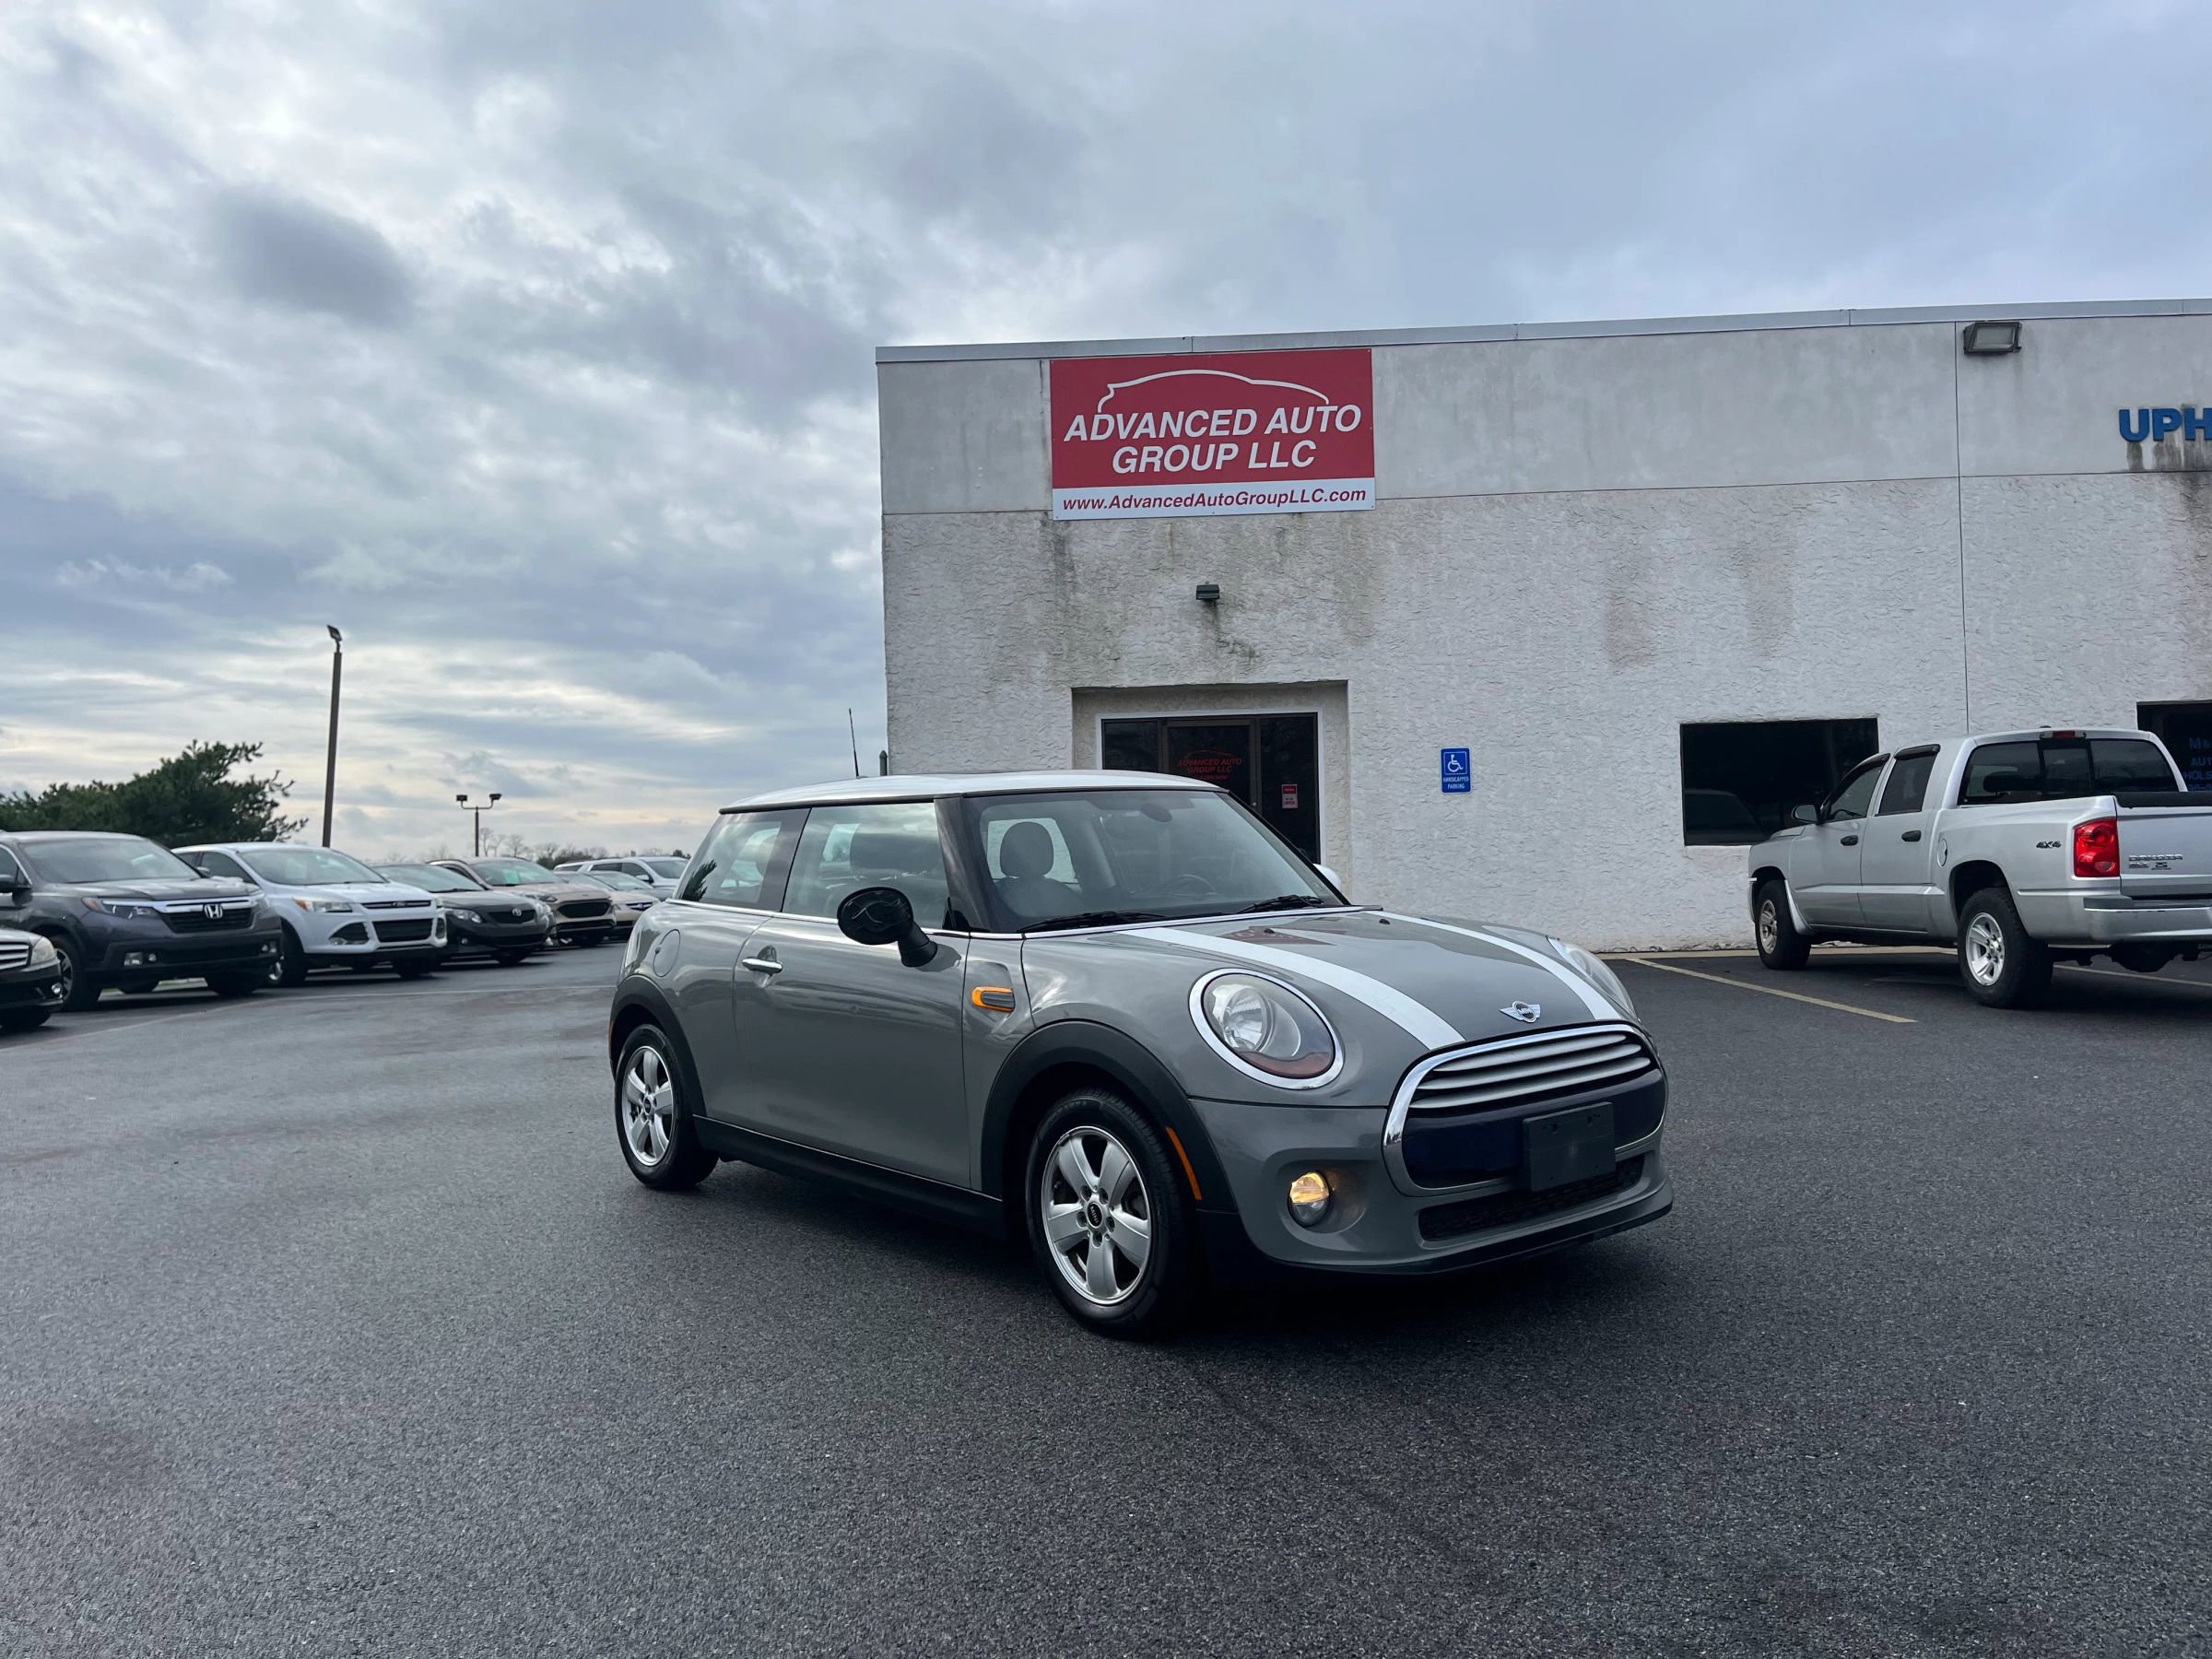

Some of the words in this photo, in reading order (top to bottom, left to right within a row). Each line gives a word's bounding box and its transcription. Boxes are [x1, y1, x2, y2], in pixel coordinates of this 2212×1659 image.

[1064, 409, 1257, 441] ADVANCED
[1265, 404, 1361, 435] AUTO
[2119, 408, 2212, 442] UPH
[1112, 443, 1239, 474] GROUP
[1247, 440, 1316, 469] LLC
[1063, 488, 1367, 511] www.AdvancedAutoGroupLLC.com
[1179, 759, 1219, 767] ADVANCED
[1220, 758, 1242, 766] AUTO
[1187, 766, 1216, 774] GROUP
[1217, 765, 1232, 773] LLC
[1089, 1206, 1100, 1224] MINI
